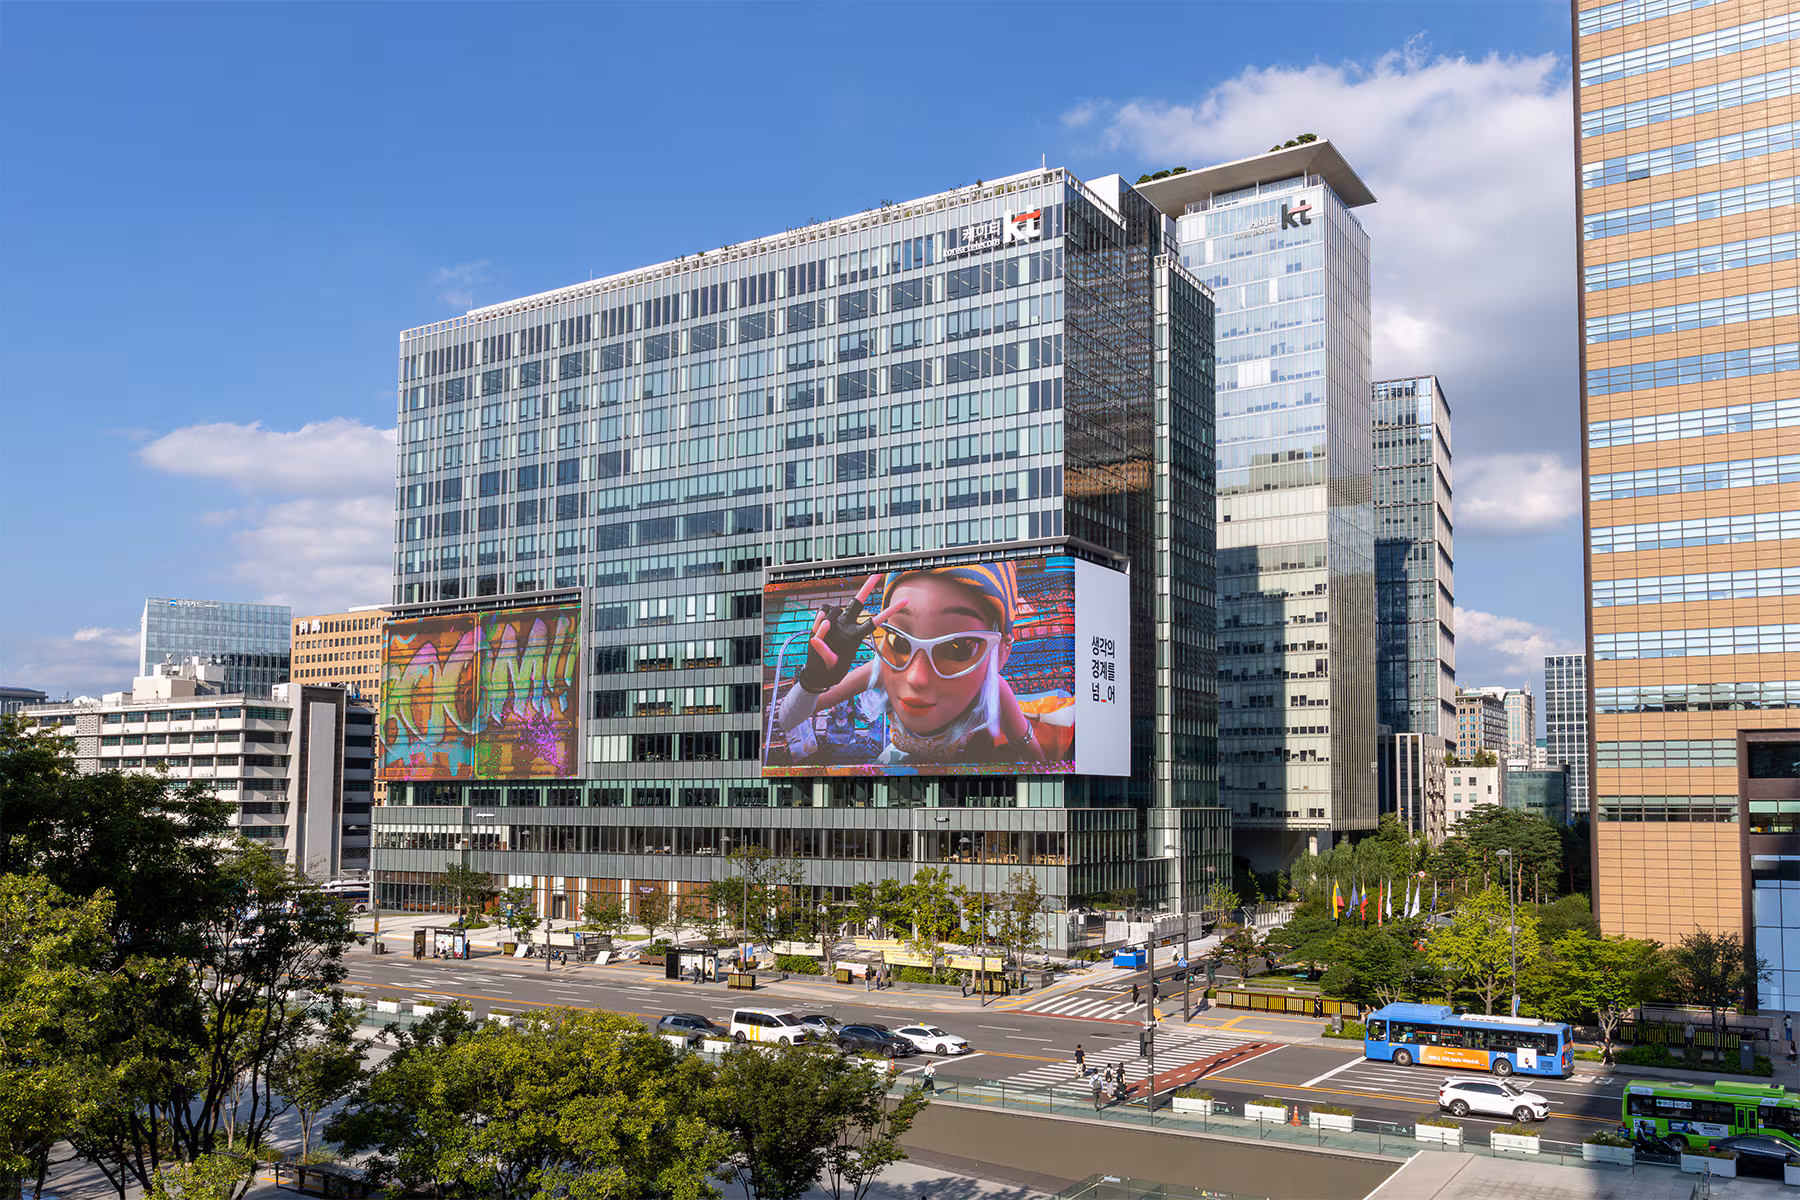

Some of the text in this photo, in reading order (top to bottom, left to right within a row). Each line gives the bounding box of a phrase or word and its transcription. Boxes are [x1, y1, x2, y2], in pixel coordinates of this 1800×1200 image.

[1003, 204, 1041, 244] kt
[1281, 199, 1313, 230] kt
[962, 220, 1000, 242] 케이티
[1091, 635, 1115, 659] 생각의
[1091, 659, 1115, 682] 경계를
[1496, 1051, 1509, 1059] 606
